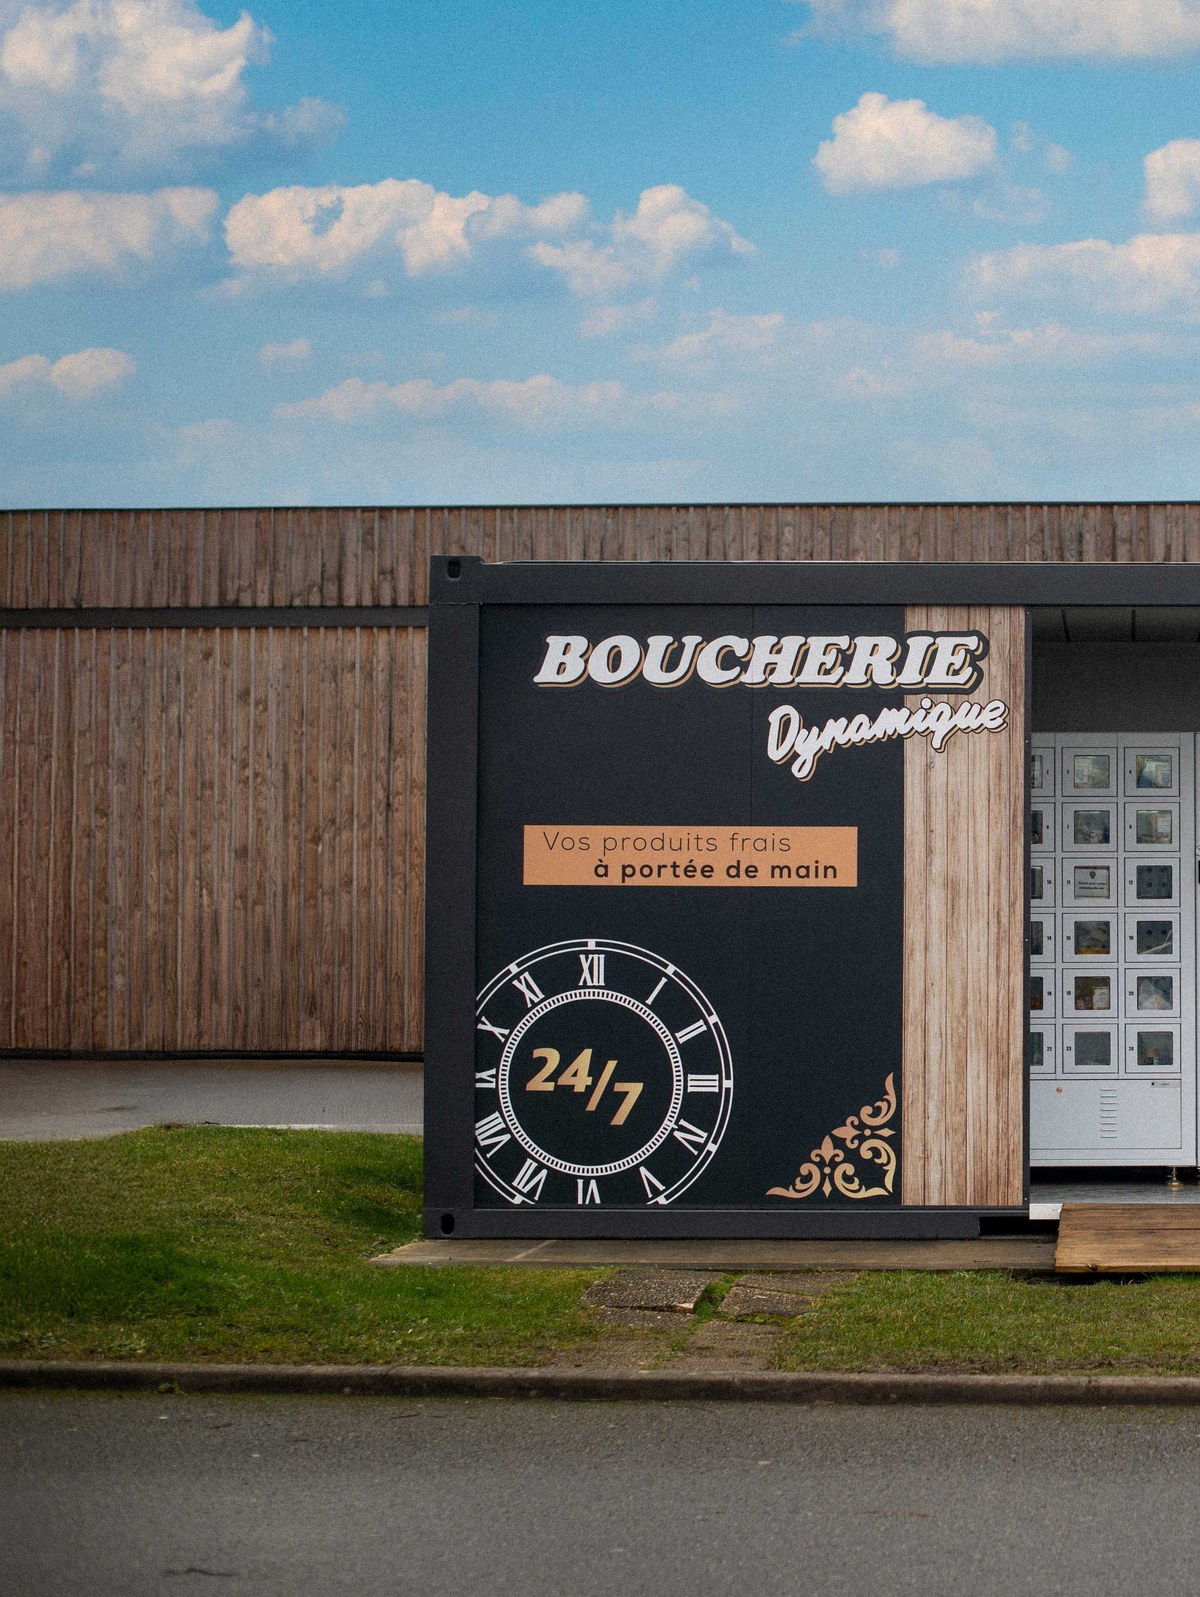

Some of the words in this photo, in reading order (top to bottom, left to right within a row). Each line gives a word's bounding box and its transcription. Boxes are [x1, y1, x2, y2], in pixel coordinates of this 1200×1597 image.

[533, 635, 981, 687] BOUCHERIE
[767, 698, 1008, 779] Dynamique
[543, 832, 590, 851] Vos
[603, 833, 718, 856] produits
[730, 833, 791, 852] frais
[594, 859, 609, 878] à
[621, 859, 715, 883] portée
[726, 860, 759, 878] de
[770, 860, 837, 878] main
[578, 954, 605, 986] XII
[512, 971, 545, 1008] XI
[525, 1047, 644, 1126] 24/7
[687, 1073, 719, 1093] III
